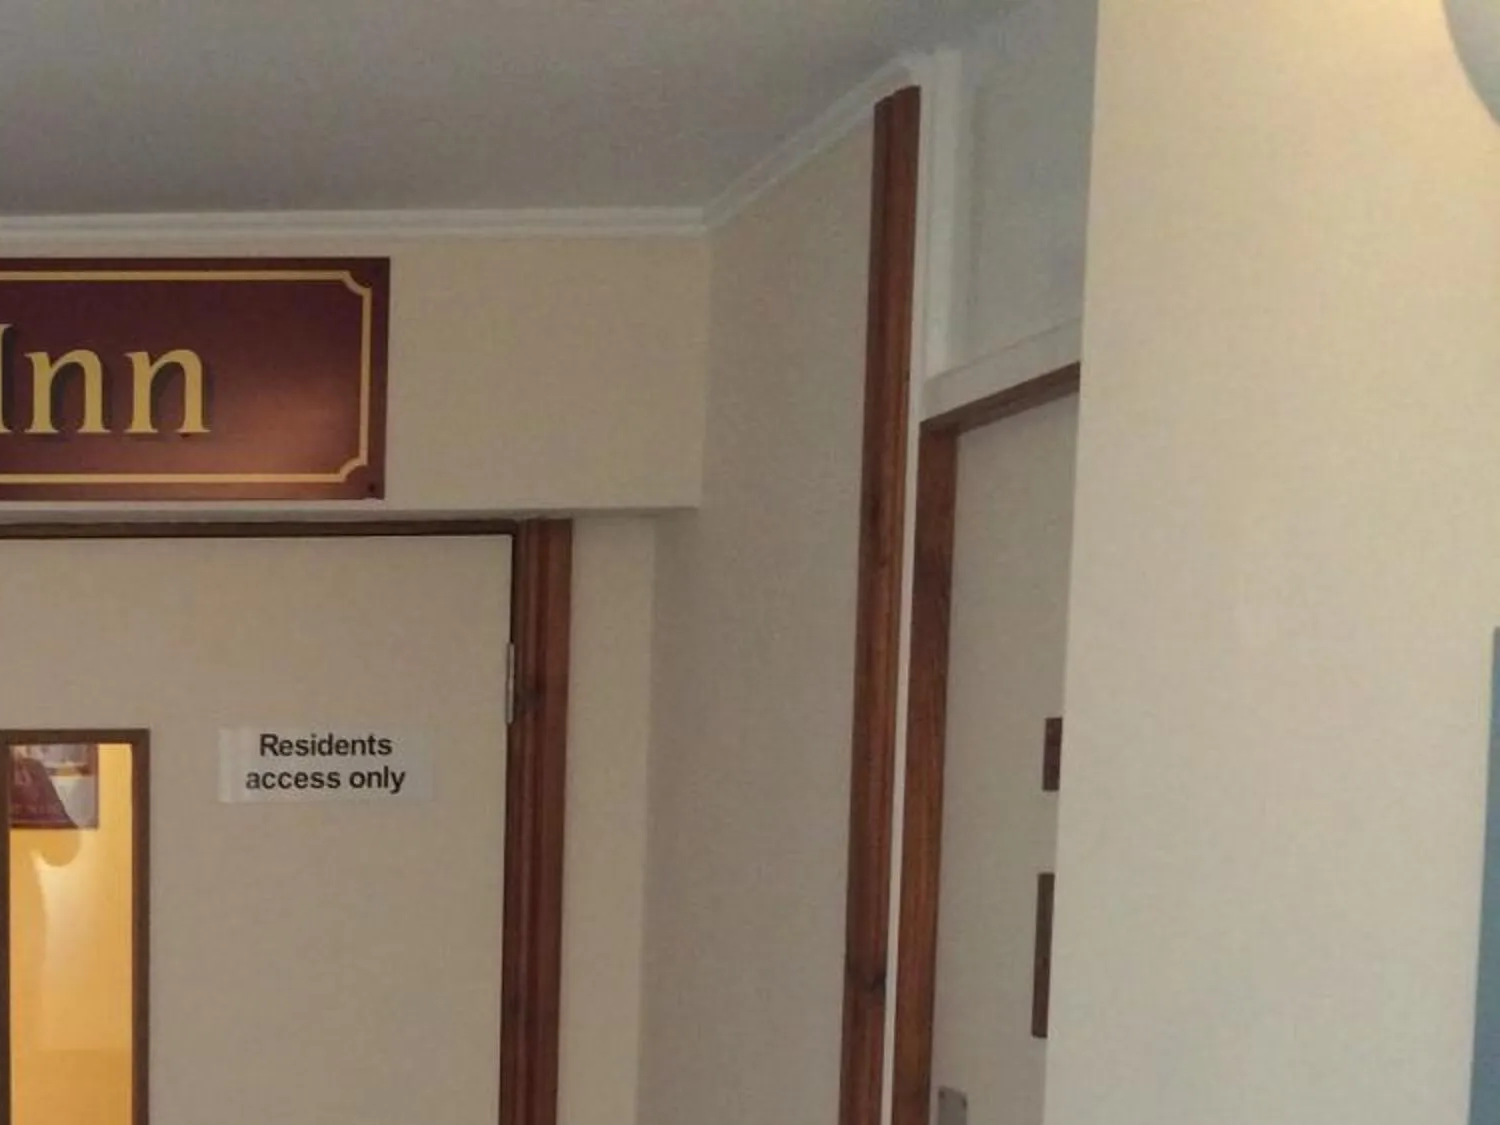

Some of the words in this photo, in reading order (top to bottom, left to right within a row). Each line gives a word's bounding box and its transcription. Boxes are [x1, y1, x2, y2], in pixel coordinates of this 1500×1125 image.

[258, 733, 393, 757] Residents
[245, 769, 341, 790] access
[348, 765, 406, 794] only
